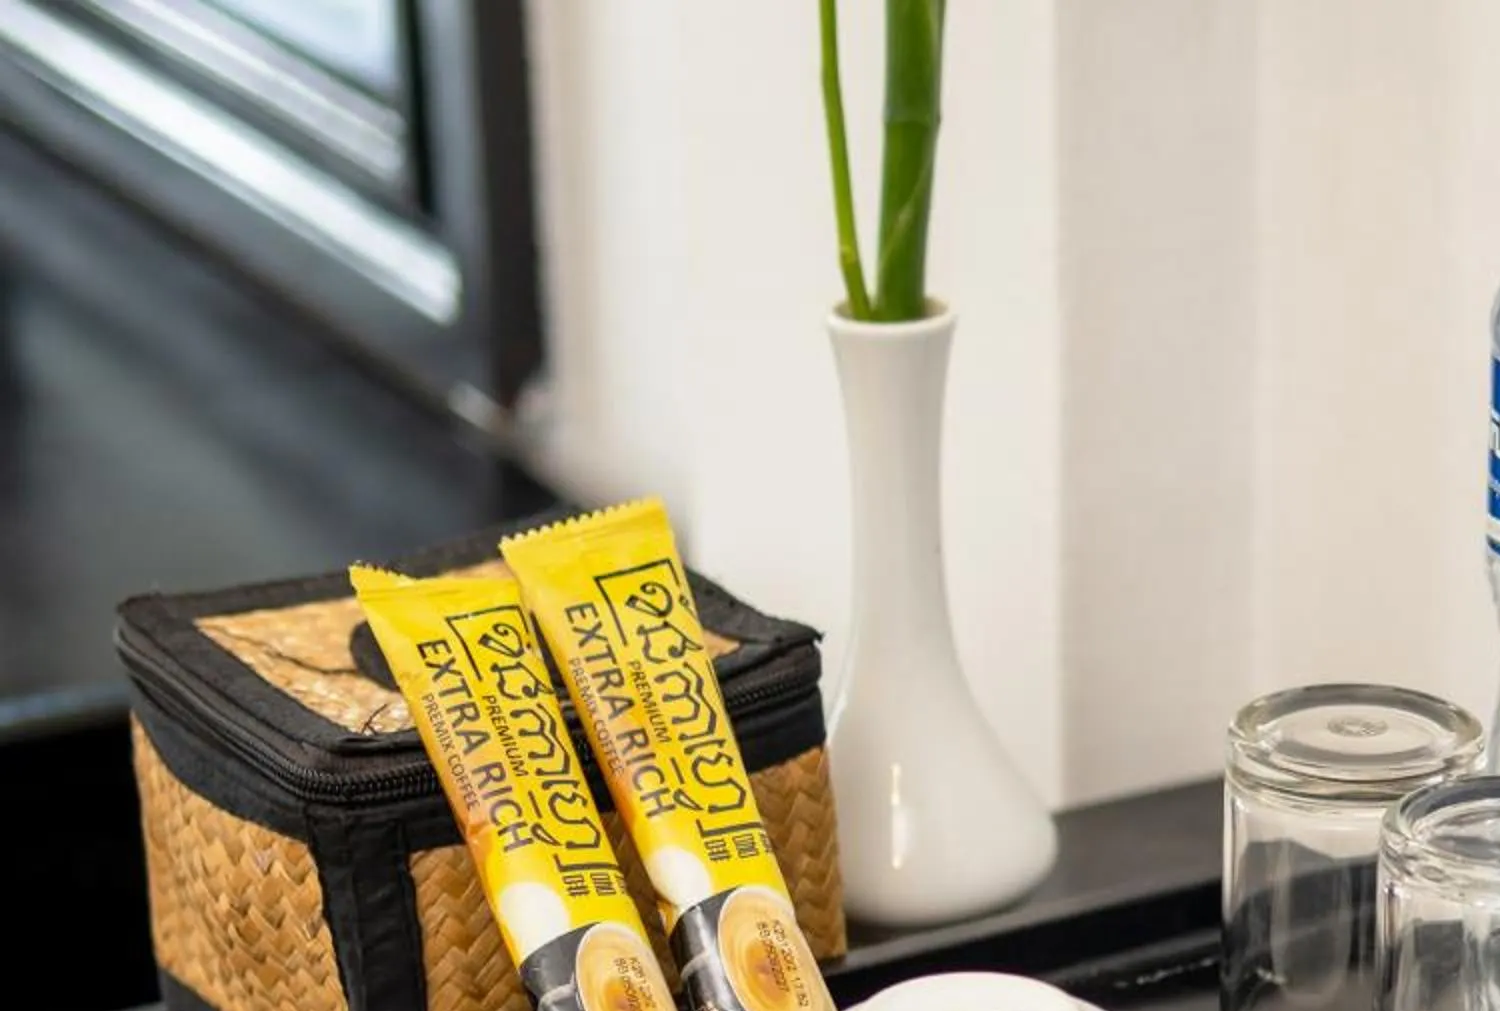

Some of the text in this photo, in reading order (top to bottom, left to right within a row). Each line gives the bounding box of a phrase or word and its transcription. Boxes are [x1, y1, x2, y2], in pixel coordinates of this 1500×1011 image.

[415, 635, 538, 853] EXTRA RICH
[419, 693, 481, 811] PREMIX COFFEE
[480, 694, 530, 778] PREMIUM
[563, 600, 675, 819] EXTRA RICH
[566, 657, 625, 778] PREMIX COFFEE
[626, 659, 672, 744] PREMIUM
